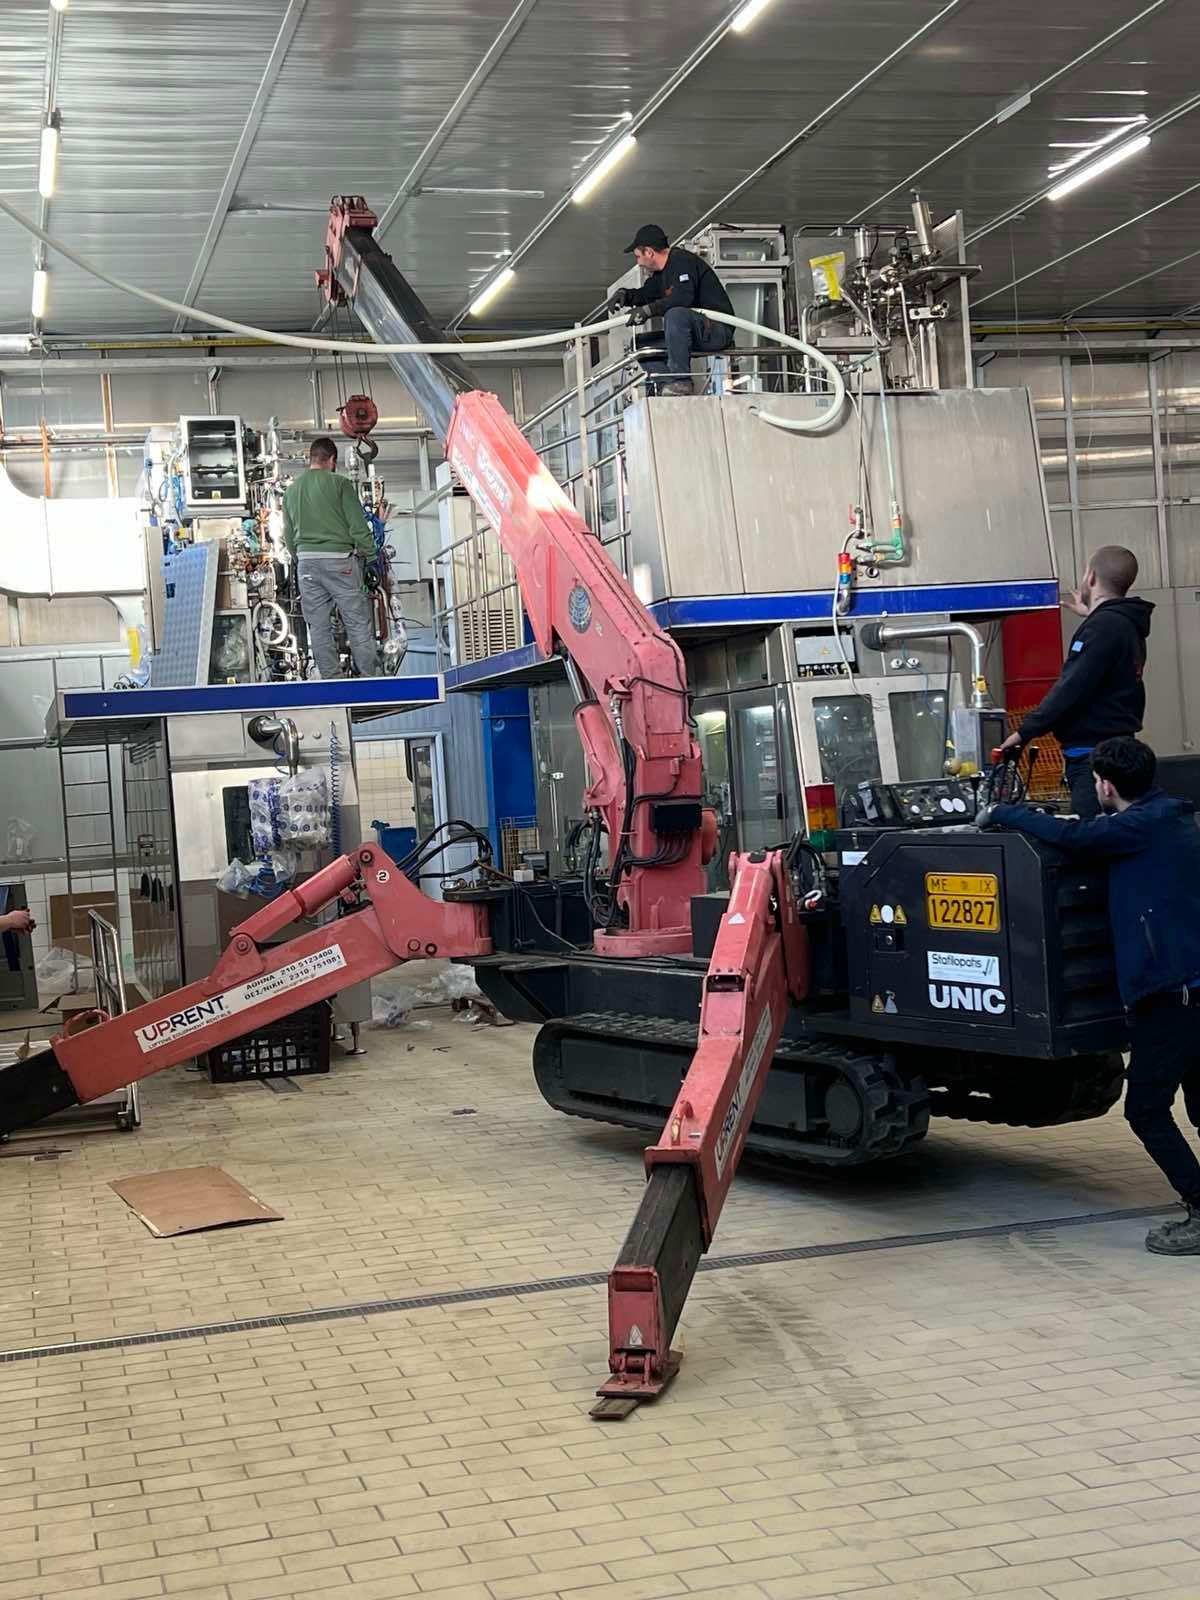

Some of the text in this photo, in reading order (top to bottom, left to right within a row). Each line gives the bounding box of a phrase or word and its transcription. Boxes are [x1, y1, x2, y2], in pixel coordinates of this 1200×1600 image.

[378, 871, 387, 881] 2
[931, 898, 995, 926] 122827
[280, 964, 296, 976] 210
[298, 948, 334, 968] 5123400
[288, 968, 310, 981] 2310
[928, 983, 1006, 1014] UNIC
[142, 995, 225, 1041] UPRENT
